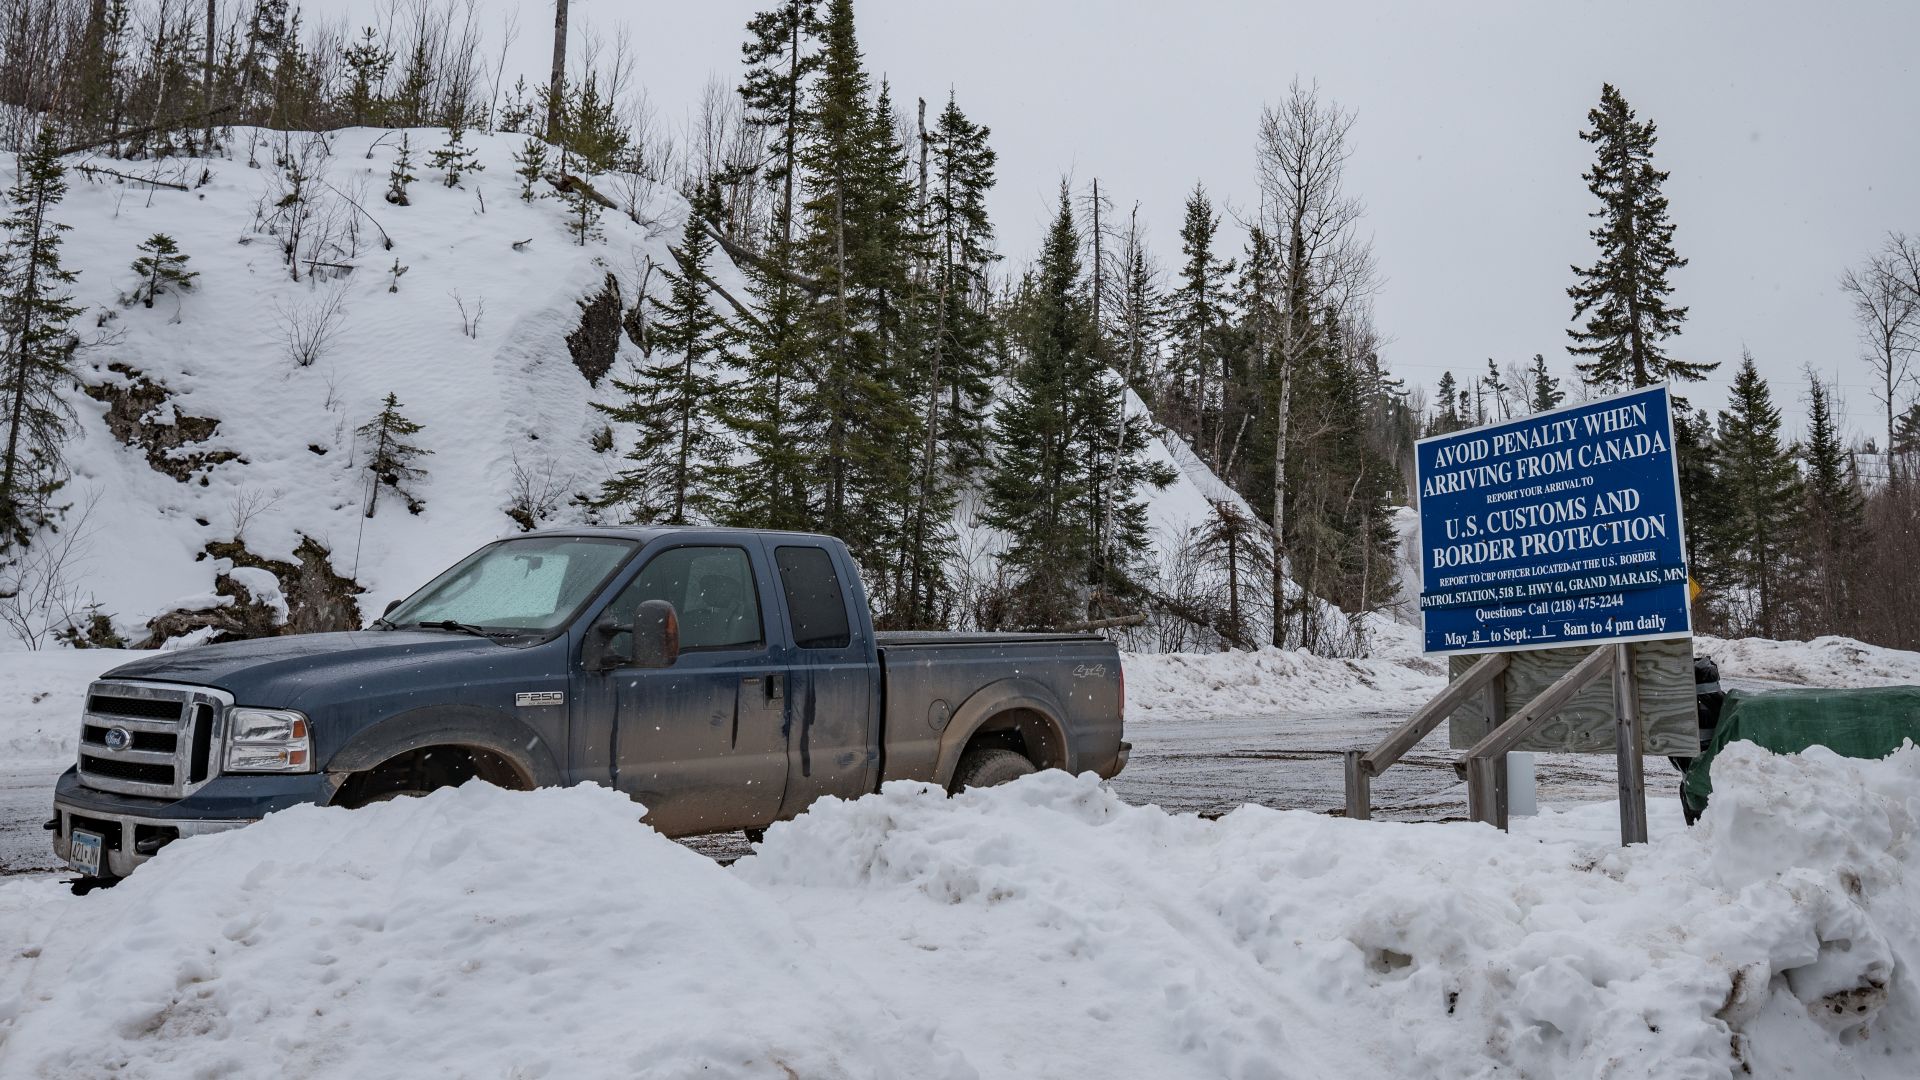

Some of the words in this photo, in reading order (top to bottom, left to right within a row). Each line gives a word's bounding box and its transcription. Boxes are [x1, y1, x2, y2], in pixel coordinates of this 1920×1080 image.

[1435, 439, 1489, 469] AVOID
[1492, 418, 1578, 457] PENALTY
[1583, 402, 1647, 437] WHEN
[1423, 461, 1513, 498] ARRIVING
[1516, 448, 1575, 480] FROM
[1578, 430, 1667, 468] CANADA
[1486, 490, 1518, 504] REPORT
[1519, 485, 1543, 498] YOUR
[1544, 479, 1582, 494] ARRIVAL
[1581, 475, 1594, 487] TO
[1445, 514, 1484, 540] U.S.
[1486, 496, 1587, 534] CUSTOMS
[1592, 488, 1640, 517] AND
[1432, 537, 1517, 569] BORDER
[1520, 513, 1666, 557] PROTECTION
[1420, 592, 1455, 608] PATROL
[1455, 588, 1498, 604] STATION,
[1499, 587, 1514, 599] 518
[1516, 585, 1526, 597] E.
[1528, 582, 1553, 596] HWY
[1555, 581, 1568, 594] 61,
[1568, 575, 1607, 591] GRAND
[1609, 569, 1662, 587] MARAIS,
[1439, 575, 1468, 587] REPORT
[1468, 573, 1480, 584] TO
[1481, 571, 1496, 582] CBP
[1497, 567, 1531, 580] OFFICER
[1531, 562, 1570, 576] LOCATED
[1571, 561, 1582, 572] AT
[1582, 558, 1601, 570] THE
[1601, 556, 1618, 568] U.S.
[1620, 551, 1657, 565] BORDER
[1475, 606, 1526, 623] Questions-
[1528, 601, 1549, 616] Call
[1550, 599, 1576, 615] (218)
[1577, 593, 1624, 610] 475-2244
[1444, 632, 1468, 648] May
[1490, 630, 1501, 642] to
[1563, 622, 1588, 636] 8am
[1591, 621, 1603, 634] to
[1604, 617, 1613, 632] 4
[1615, 620, 1634, 636] pm
[1637, 614, 1667, 632] daily
